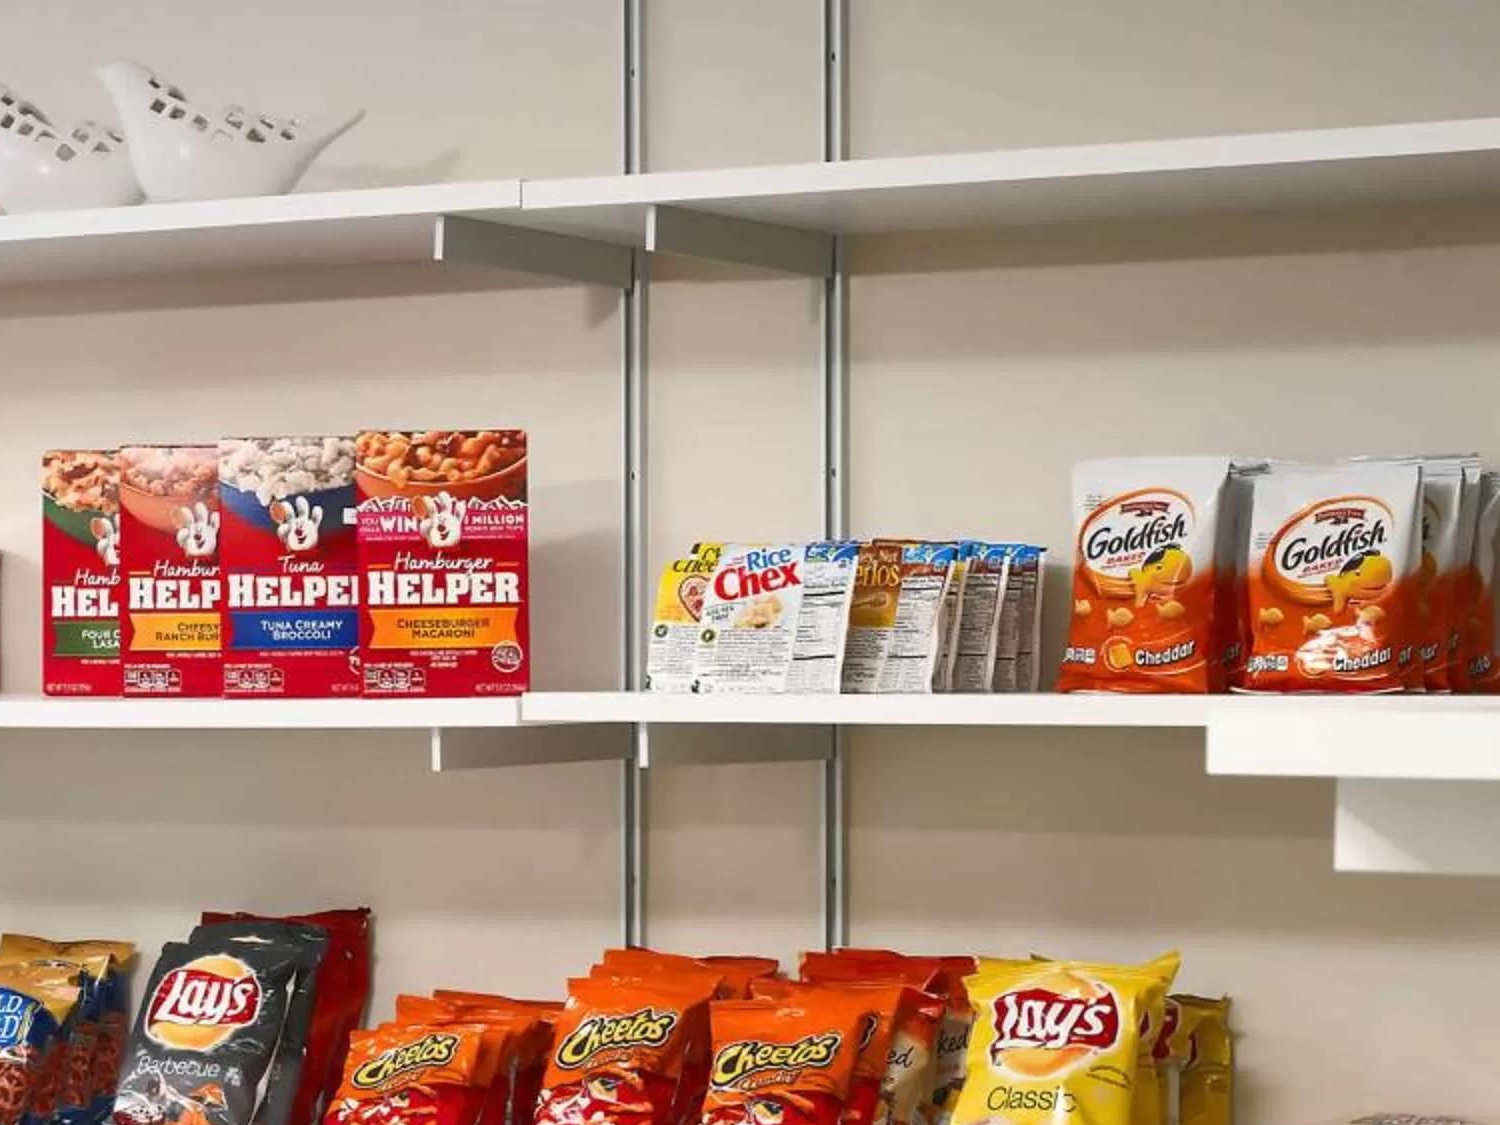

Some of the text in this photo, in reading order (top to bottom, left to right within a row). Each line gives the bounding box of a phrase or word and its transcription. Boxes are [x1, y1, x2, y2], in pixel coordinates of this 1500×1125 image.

[380, 515, 417, 533] WIN
[471, 515, 525, 525] MILLION
[1087, 514, 1186, 560] Goldfish
[1282, 520, 1386, 571] Goldfish
[153, 559, 220, 578] Hambur
[278, 554, 324, 573] Tuna
[394, 551, 493, 577] Hamburger
[746, 548, 791, 571] Rice
[129, 578, 221, 609] HELP
[228, 574, 359, 608] HELPE
[367, 571, 520, 605] HELPER
[714, 562, 803, 601] Chex
[52, 586, 119, 617] HEL
[260, 620, 343, 631] TUNA CREAMY
[273, 630, 331, 640] BROCCOLI
[396, 618, 491, 629] CHEESEBURGER
[411, 628, 476, 639] MACARONI
[93, 638, 120, 648] LASA
[1135, 640, 1195, 665] Cheddar
[154, 970, 256, 1026] Lay's
[995, 993, 1110, 1050] Lay's
[557, 1008, 676, 1069] Cheetos
[137, 1055, 221, 1078] Barbecue
[353, 1033, 460, 1089] Cheetos
[711, 1030, 843, 1089] Cheetos
